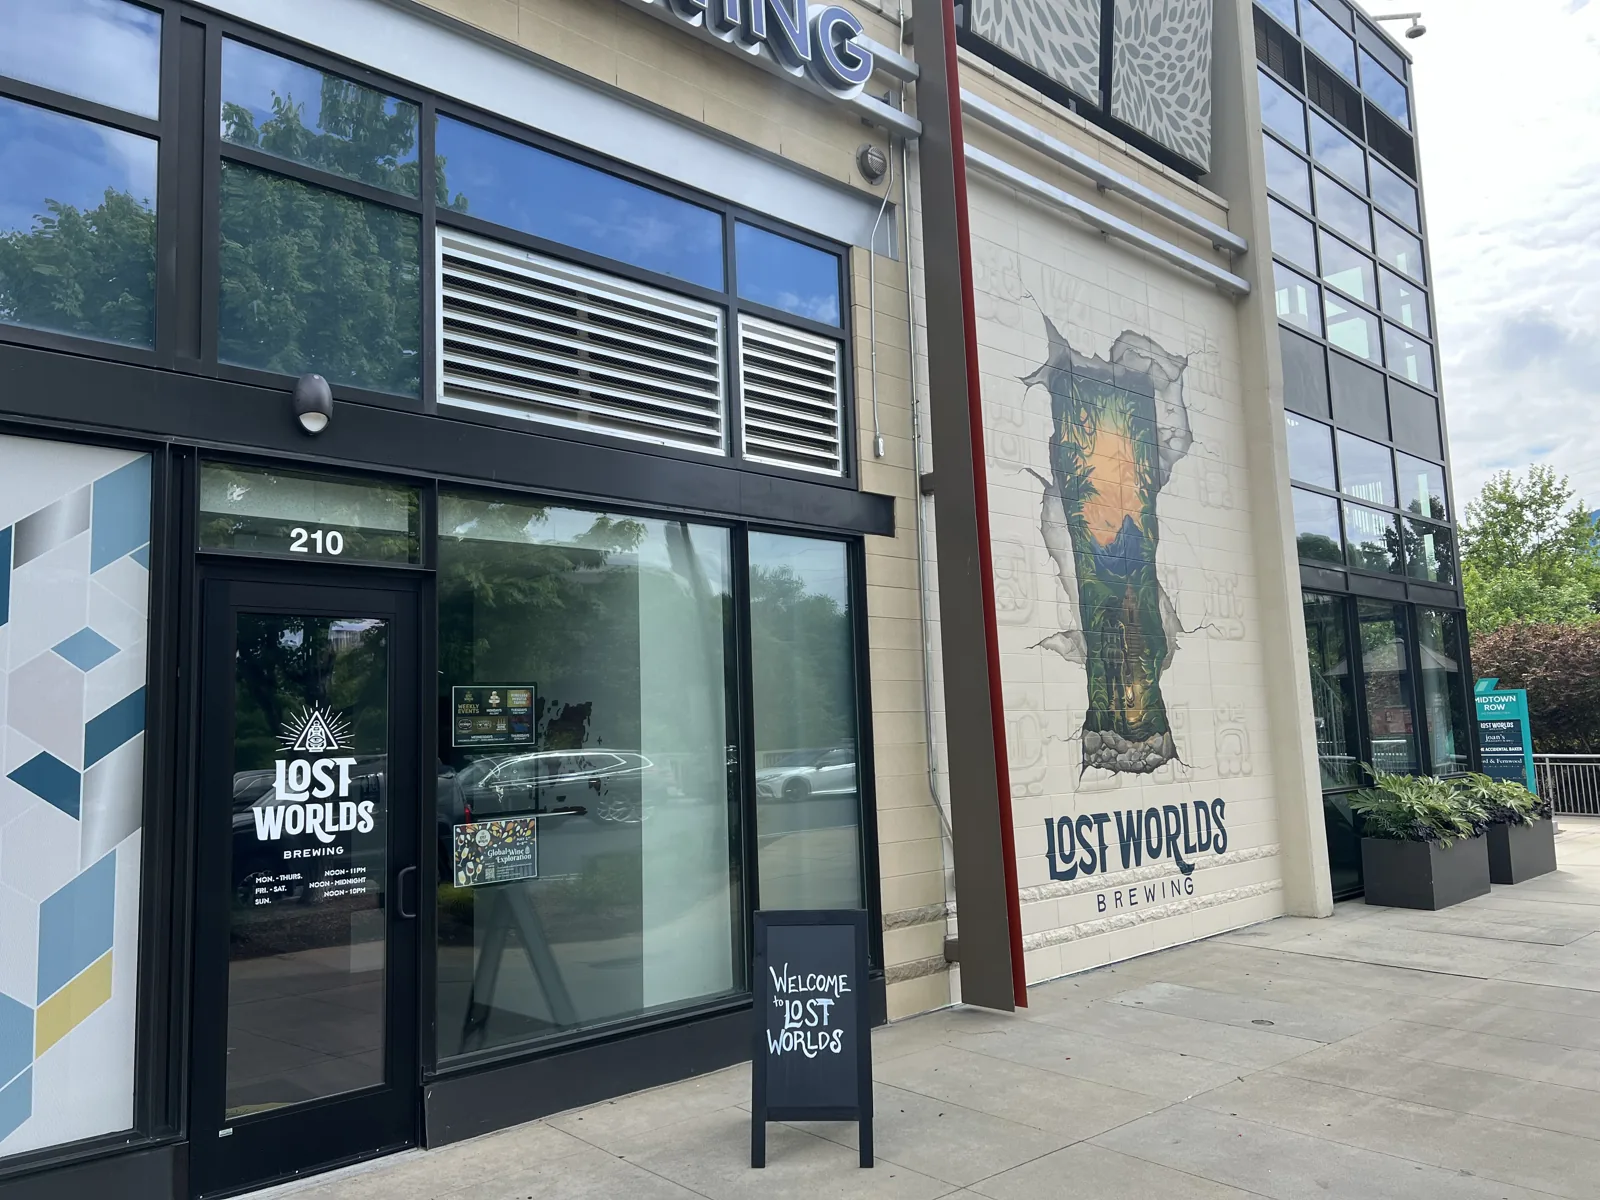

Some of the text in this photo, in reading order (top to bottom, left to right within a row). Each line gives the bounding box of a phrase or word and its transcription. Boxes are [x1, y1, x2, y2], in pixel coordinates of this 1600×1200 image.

[289, 527, 344, 556] 210
[1492, 722, 1514, 730] WORLDS
[272, 757, 358, 802] LOST
[252, 800, 375, 844] WORLDS
[284, 846, 344, 860] BREWING
[488, 848, 507, 858] Global
[1044, 798, 1228, 881] LOST WORLDS
[496, 854, 532, 864] Exploration
[280, 873, 303, 881] THURS.
[309, 880, 330, 888] NOON
[334, 876, 366, 886] MIDNIGHT
[1096, 876, 1194, 913] BREWING
[769, 962, 852, 998] WELCOME
[773, 996, 835, 1030] to LOST
[766, 1028, 844, 1058] WORLDS
